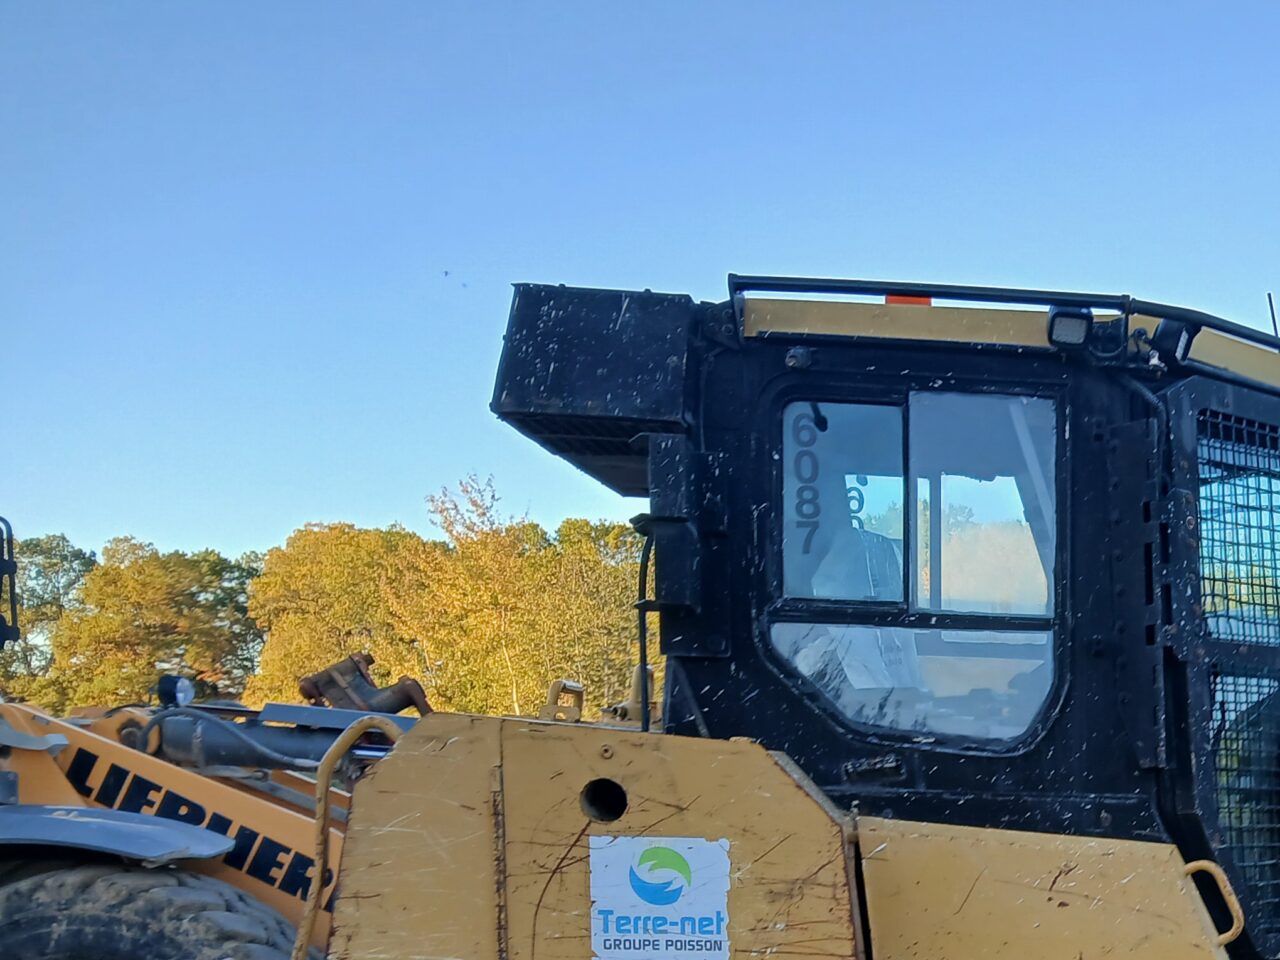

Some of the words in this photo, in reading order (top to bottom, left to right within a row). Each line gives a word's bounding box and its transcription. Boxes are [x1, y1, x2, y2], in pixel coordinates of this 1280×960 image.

[791, 413, 821, 555] 6087
[66, 747, 335, 913] LIEBHER
[597, 909, 725, 935] Terre-net
[603, 938, 660, 951] GROUPE
[665, 939, 723, 952] POISSON
